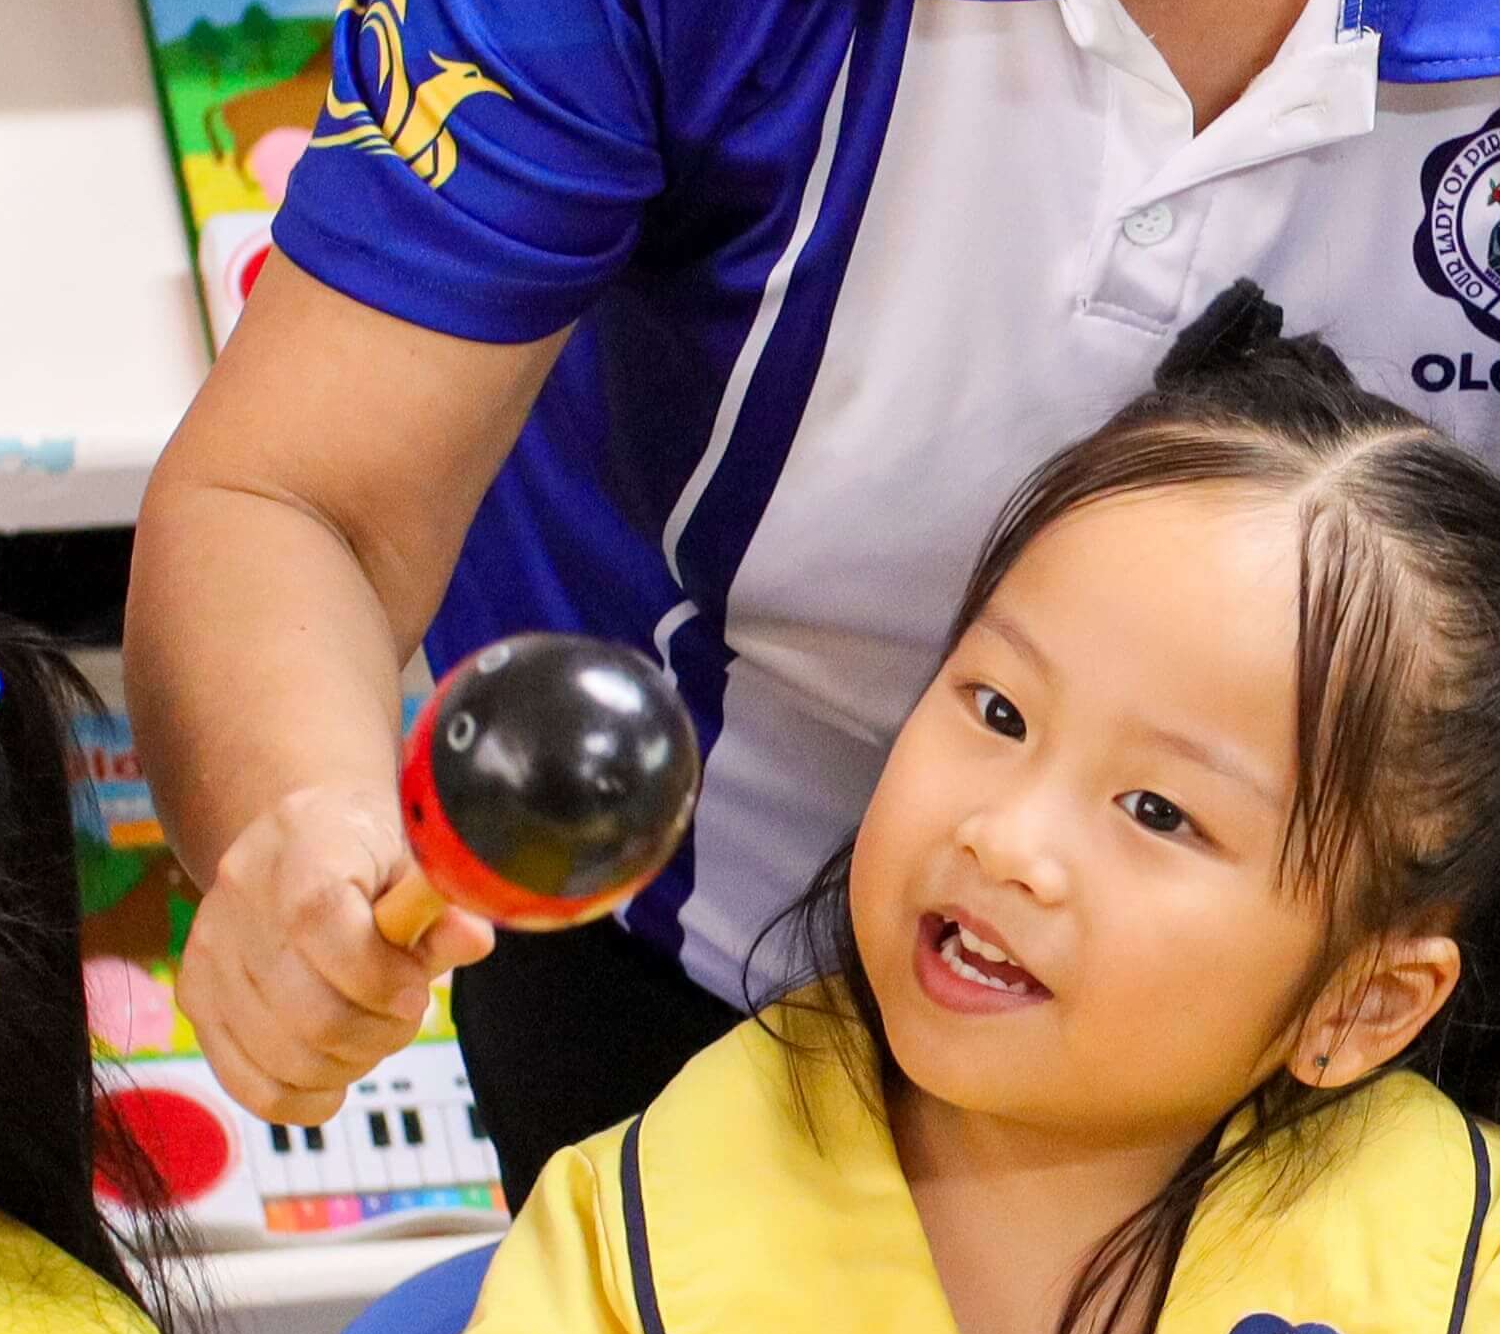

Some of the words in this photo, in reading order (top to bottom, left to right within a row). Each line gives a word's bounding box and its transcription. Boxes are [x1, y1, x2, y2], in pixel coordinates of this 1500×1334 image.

[1443, 163, 1469, 195] OF
[1435, 199, 1457, 256] LADY
[1445, 258, 1483, 298] OUR
